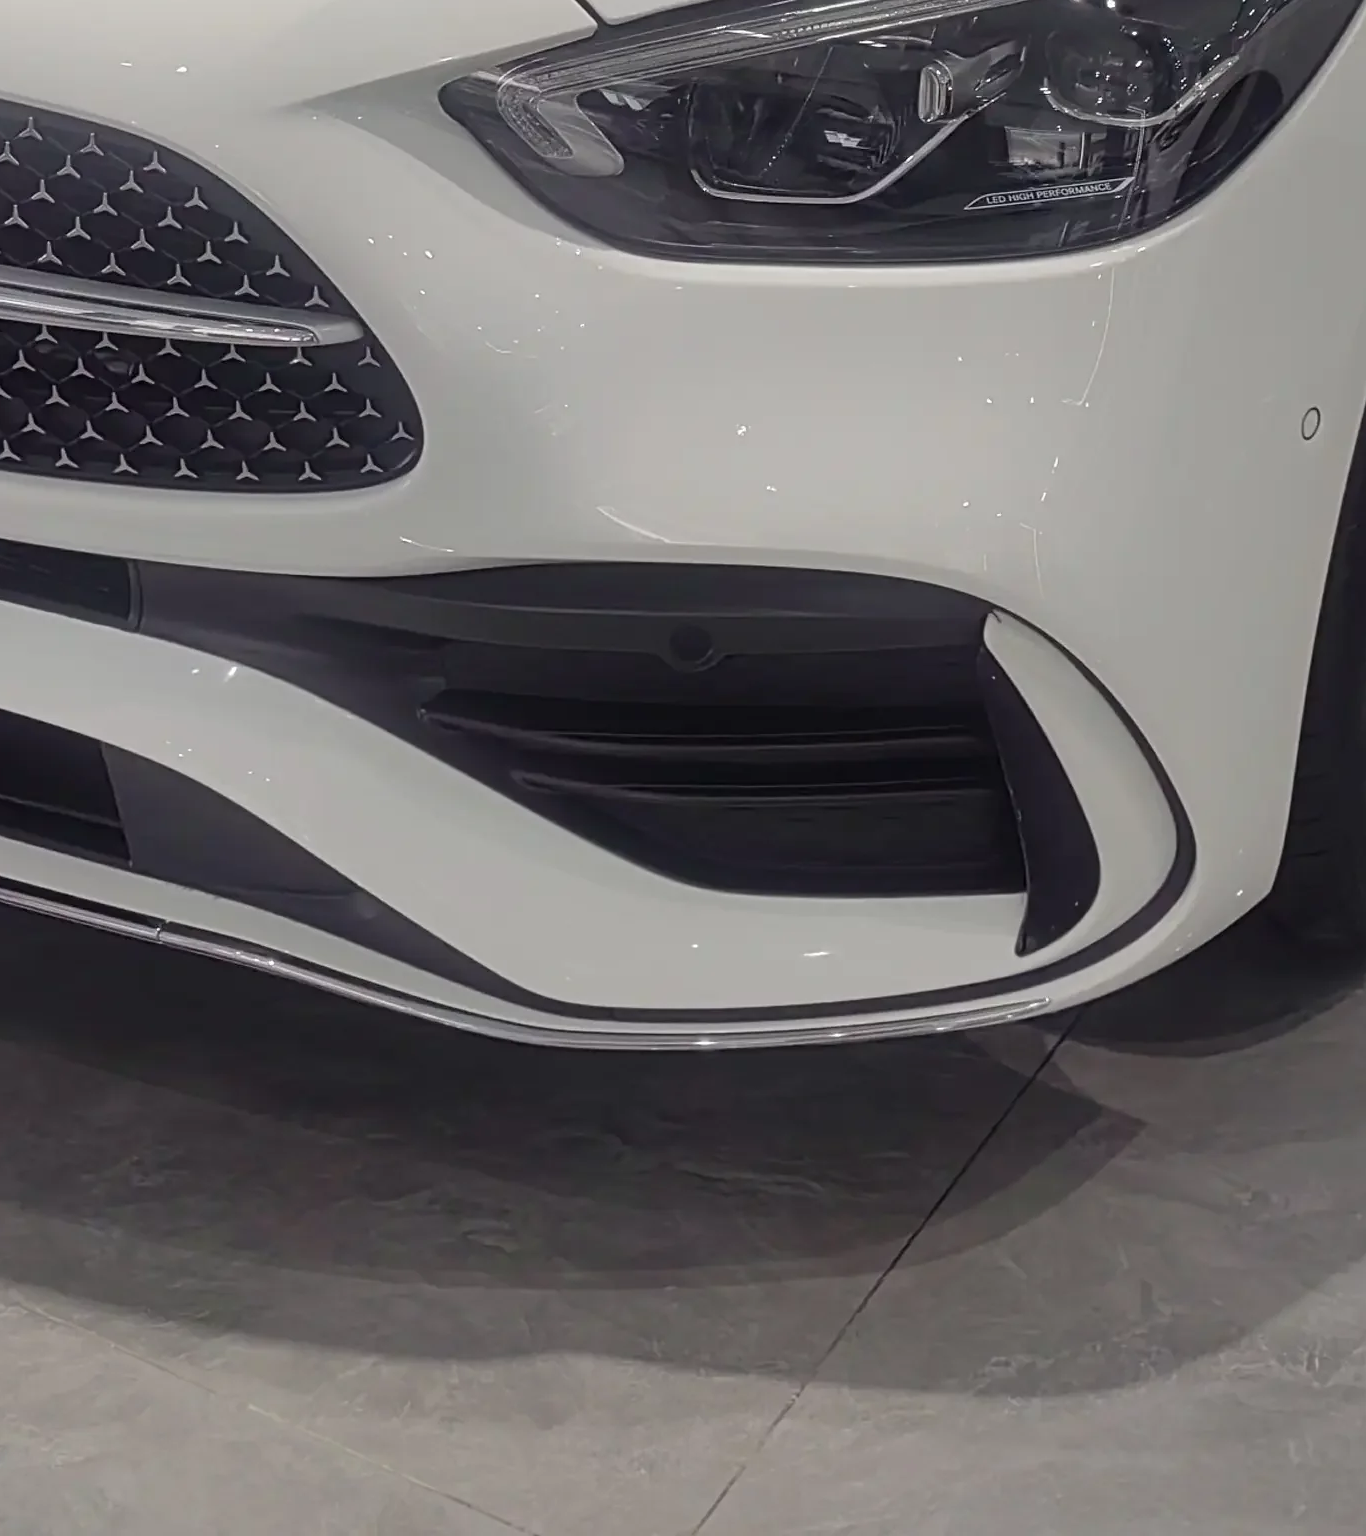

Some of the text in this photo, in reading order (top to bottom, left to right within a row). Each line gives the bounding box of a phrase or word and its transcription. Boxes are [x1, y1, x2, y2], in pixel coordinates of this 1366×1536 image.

[986, 183, 1112, 204] LED HIGH PERFORMANCE
